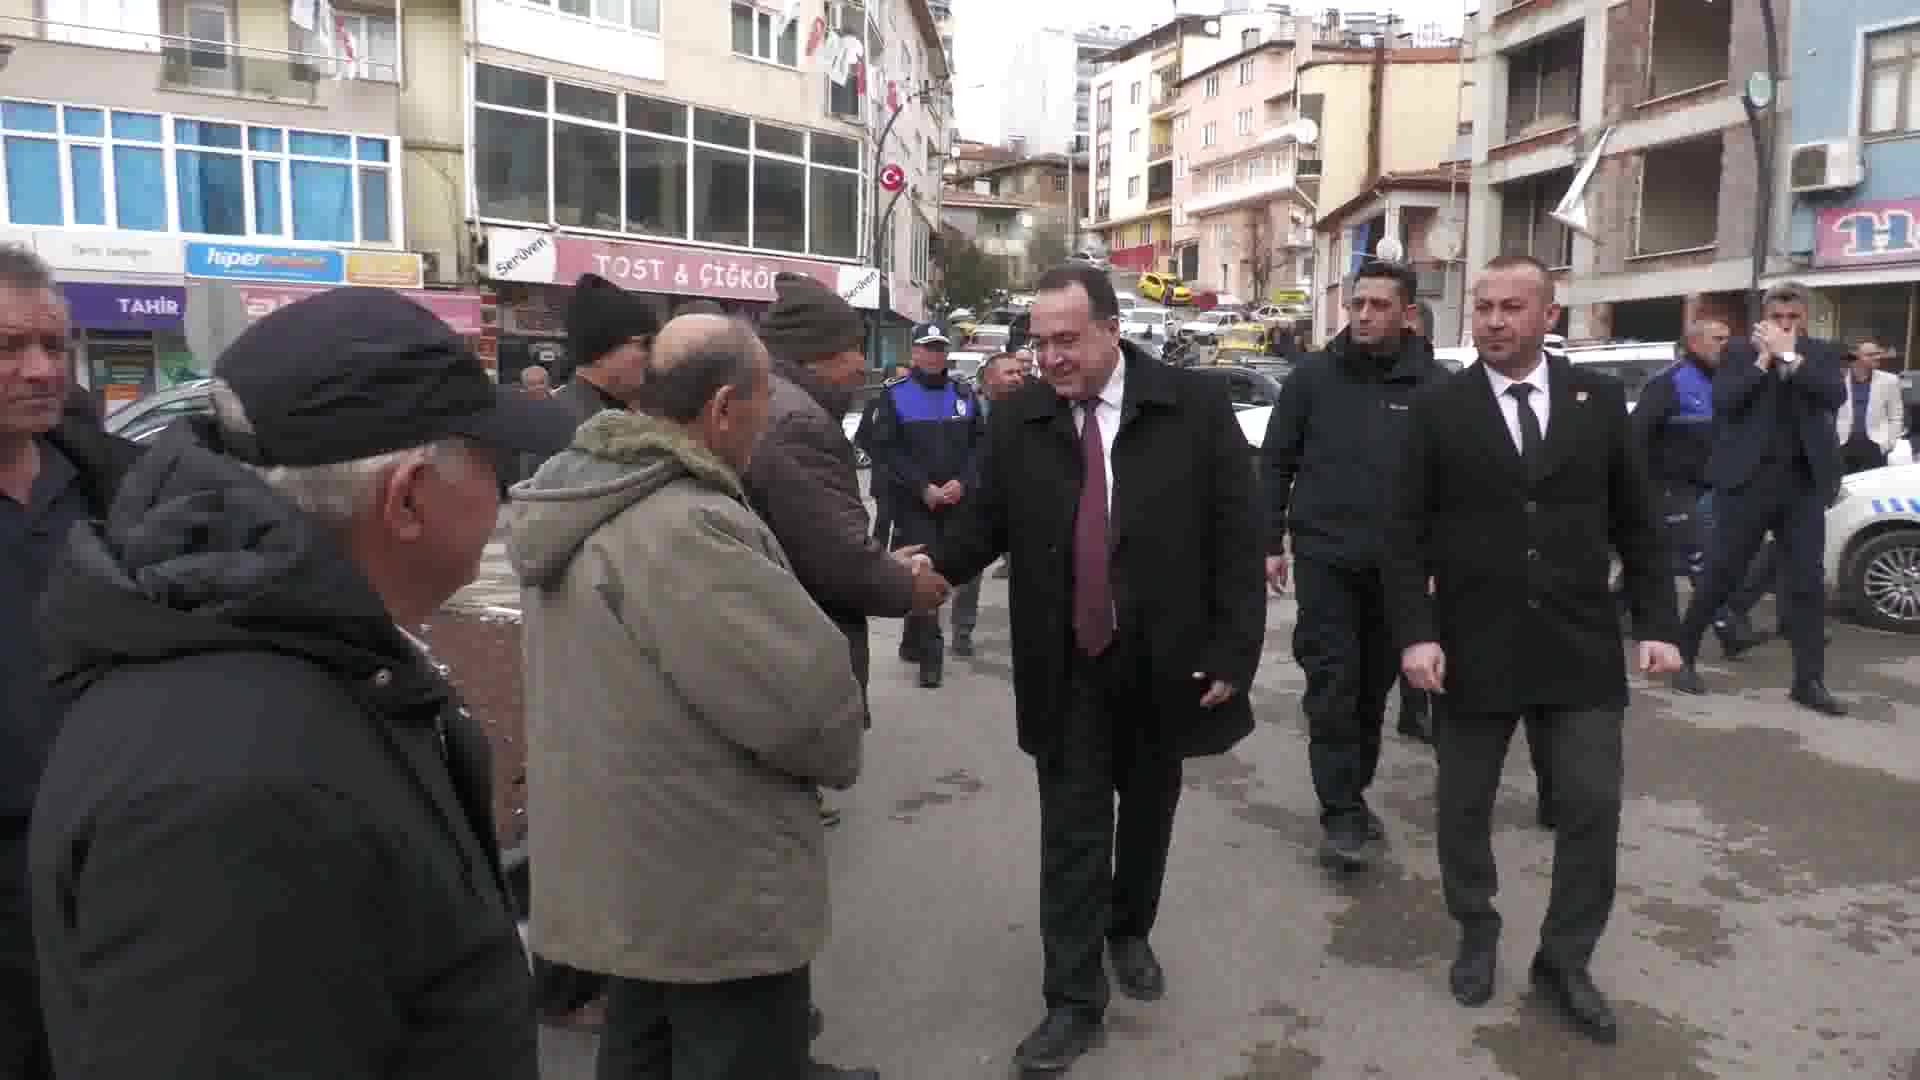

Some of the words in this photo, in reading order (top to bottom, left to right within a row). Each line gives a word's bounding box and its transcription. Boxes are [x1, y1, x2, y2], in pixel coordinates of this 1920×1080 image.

[495, 236, 547, 277] Serüven
[592, 253, 665, 282] TOST
[673, 262, 689, 286] &
[700, 257, 778, 294] ÇİĞKÖ
[115, 295, 180, 316] TAHİR
